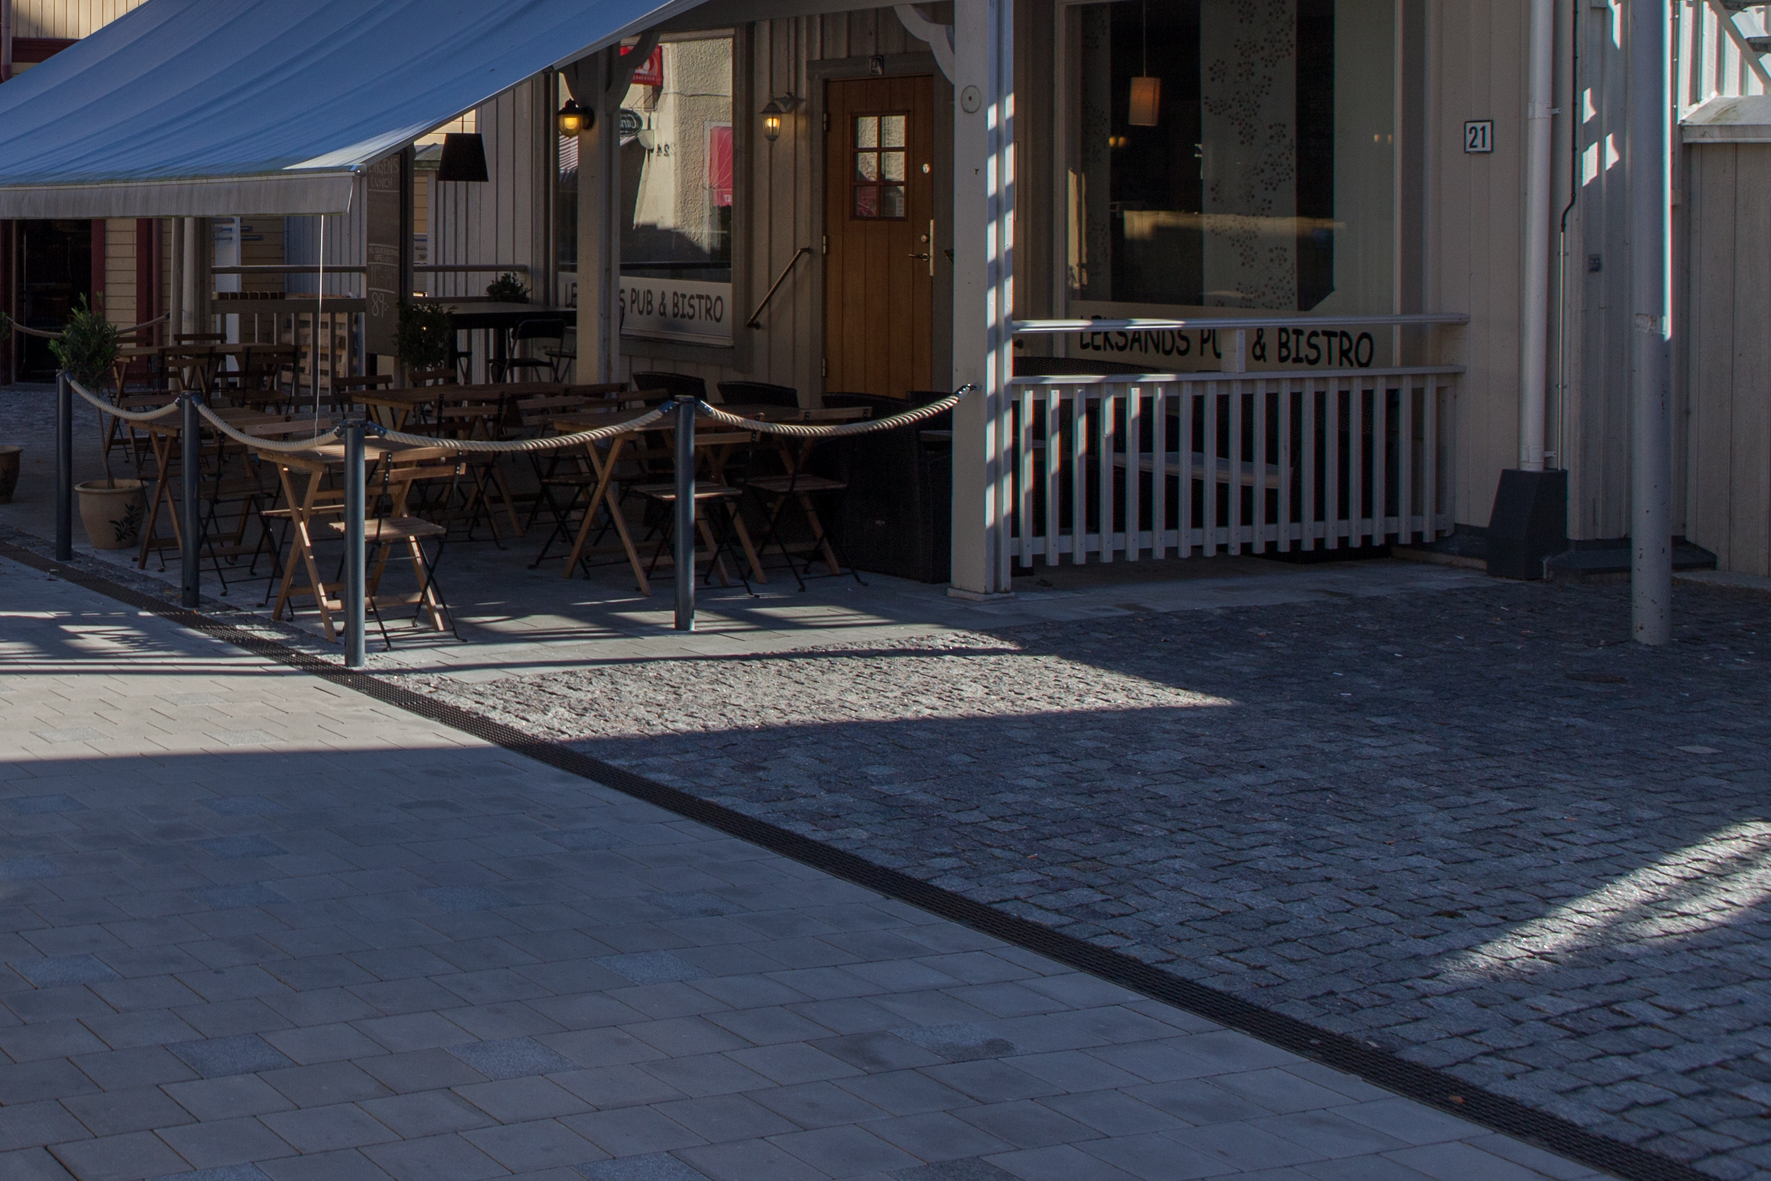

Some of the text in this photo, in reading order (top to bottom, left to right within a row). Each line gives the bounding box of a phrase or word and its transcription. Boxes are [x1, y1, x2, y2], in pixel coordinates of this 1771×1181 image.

[1468, 125, 1488, 149] 21
[630, 287, 654, 316] PUB
[658, 290, 667, 318] &
[672, 290, 724, 323] BISTRO
[1199, 327, 1222, 359] PU
[1252, 327, 1267, 363] &
[1277, 327, 1375, 369] BISTRO
